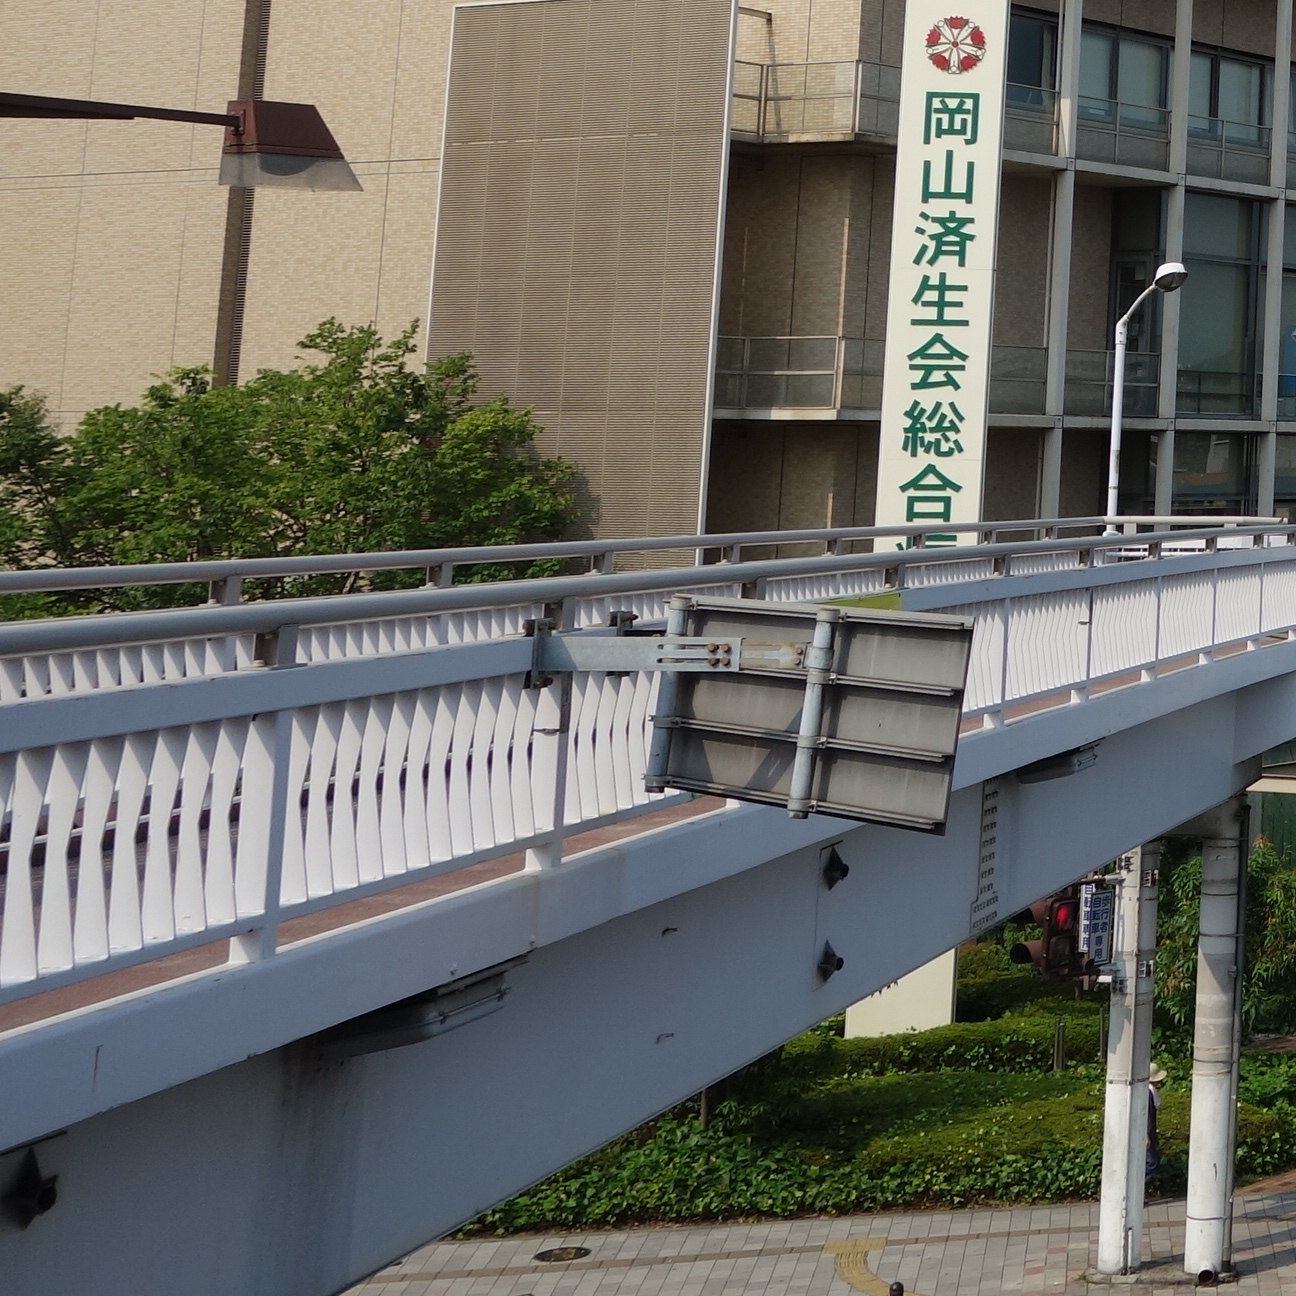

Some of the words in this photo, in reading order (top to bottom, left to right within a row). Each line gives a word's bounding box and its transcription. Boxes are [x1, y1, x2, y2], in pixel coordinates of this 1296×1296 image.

[1099, 894, 1111, 933] 歩行者
[1094, 935, 1104, 960] 専用
